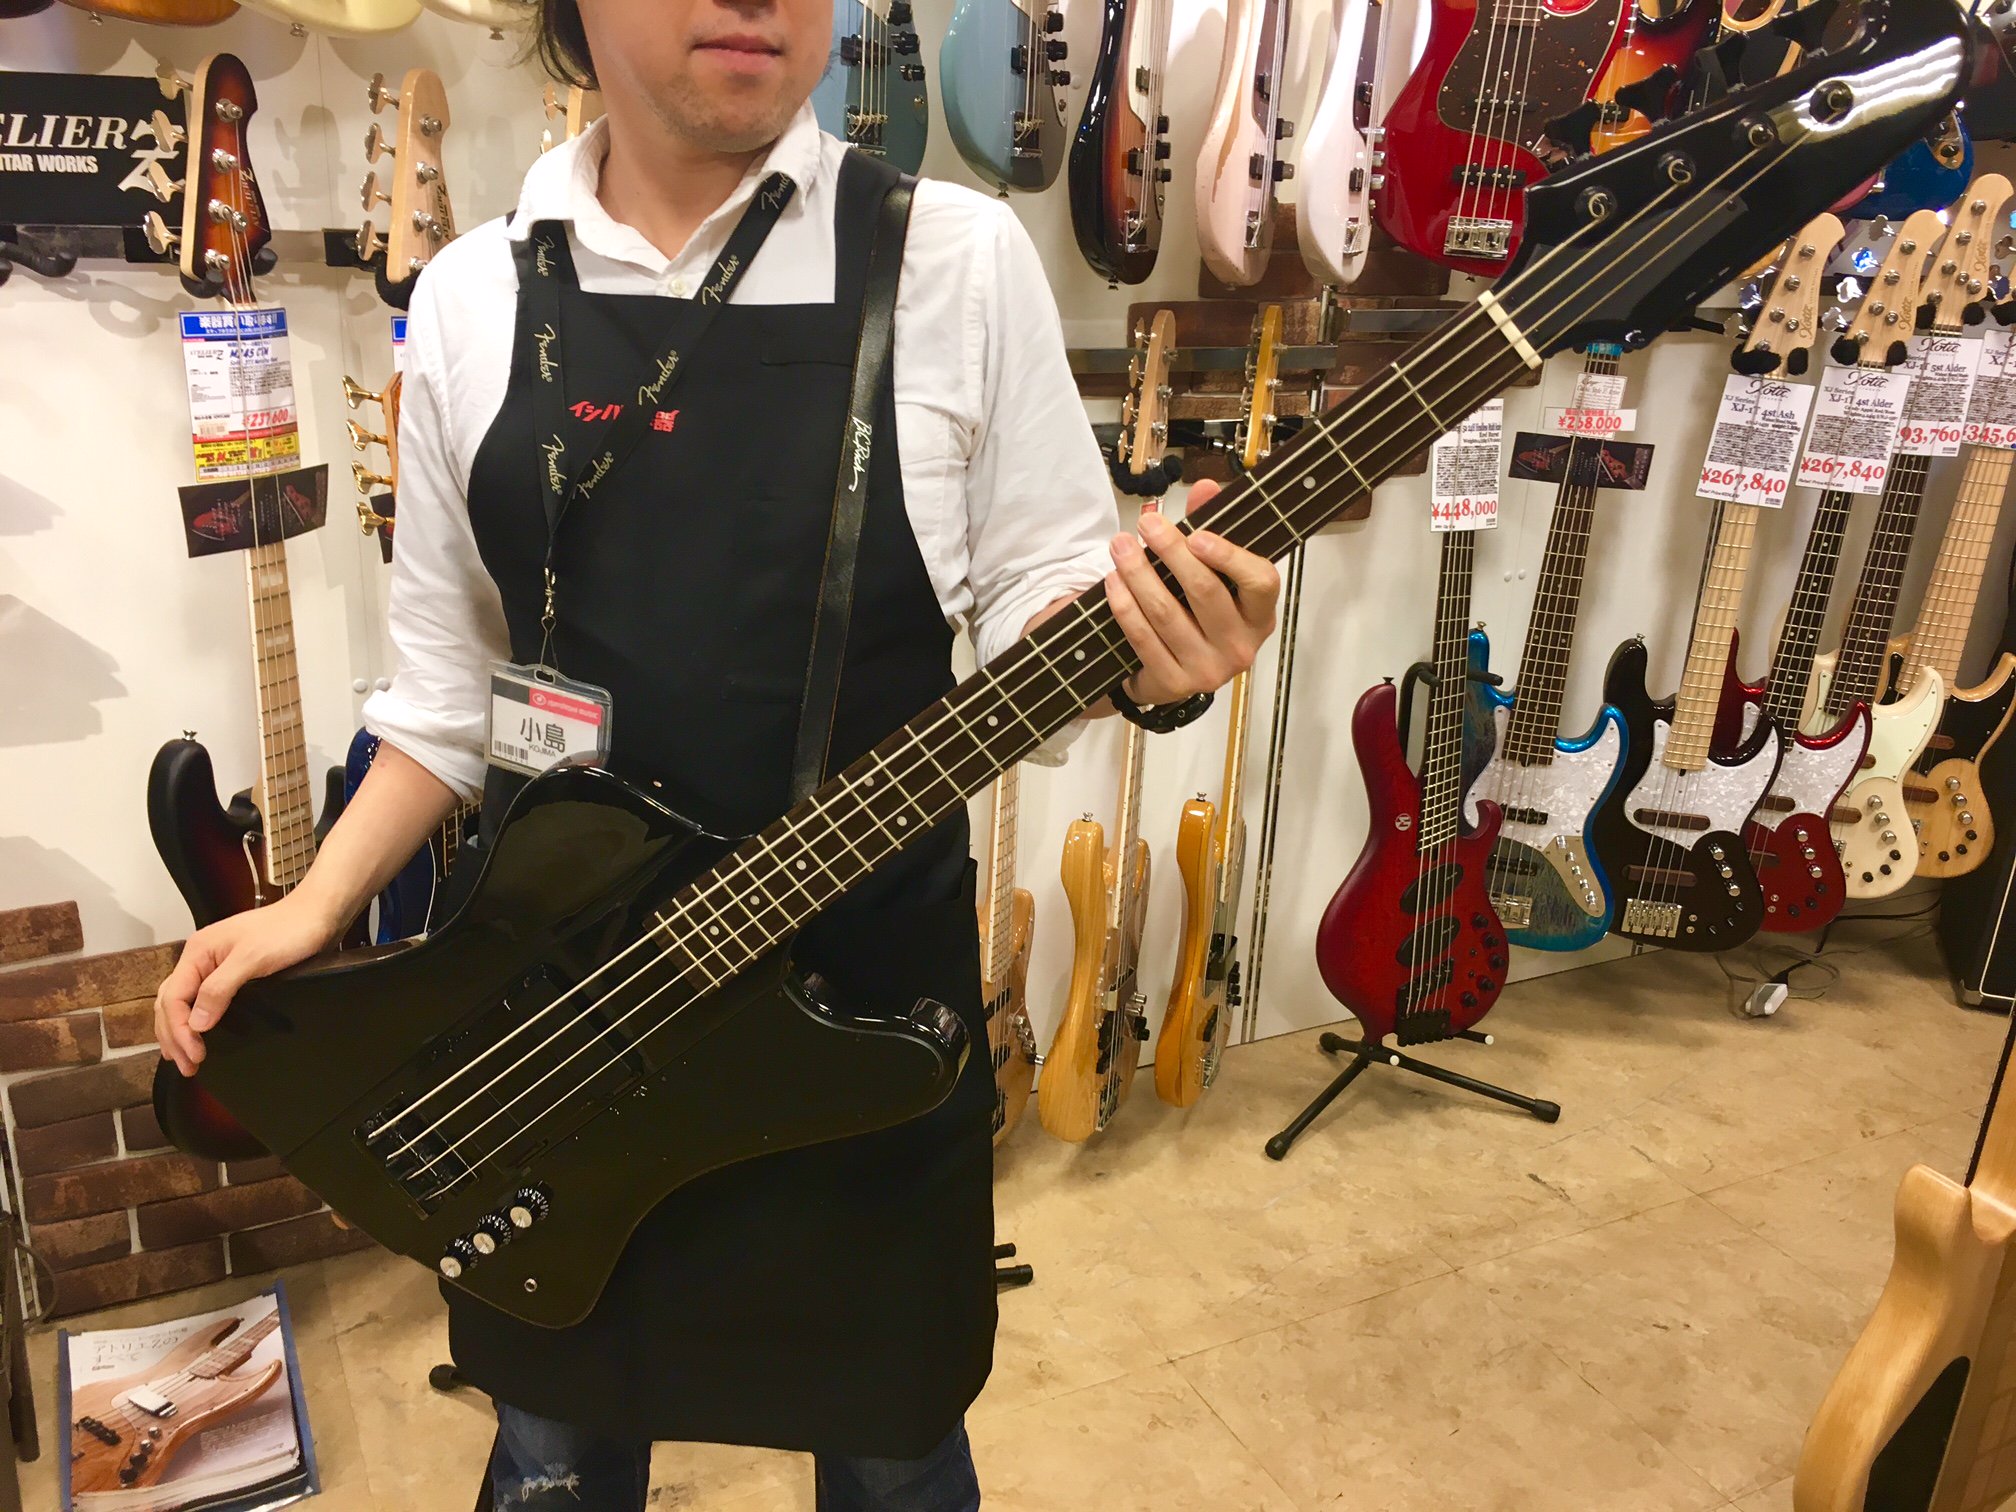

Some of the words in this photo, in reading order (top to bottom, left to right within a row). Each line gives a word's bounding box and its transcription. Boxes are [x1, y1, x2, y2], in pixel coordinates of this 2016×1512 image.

[36, 154, 99, 174] WORKS
[761, 173, 791, 210] Fend
[702, 254, 740, 306] Fender
[533, 323, 559, 383] Fender
[638, 349, 680, 406] Fender
[1745, 379, 1791, 398] Xotic
[1843, 370, 1889, 388] Xotic
[1761, 409, 1777, 421] 4st
[1778, 409, 1795, 420] Ash
[1870, 398, 1894, 408] Alder
[1896, 425, 1961, 444] 93,760
[541, 433, 568, 496] Fender
[1801, 457, 1885, 481] ¥267,840
[1701, 467, 1787, 495] ¥267,840
[1431, 498, 1497, 520] ¥448,000
[520, 717, 566, 753] 小島
